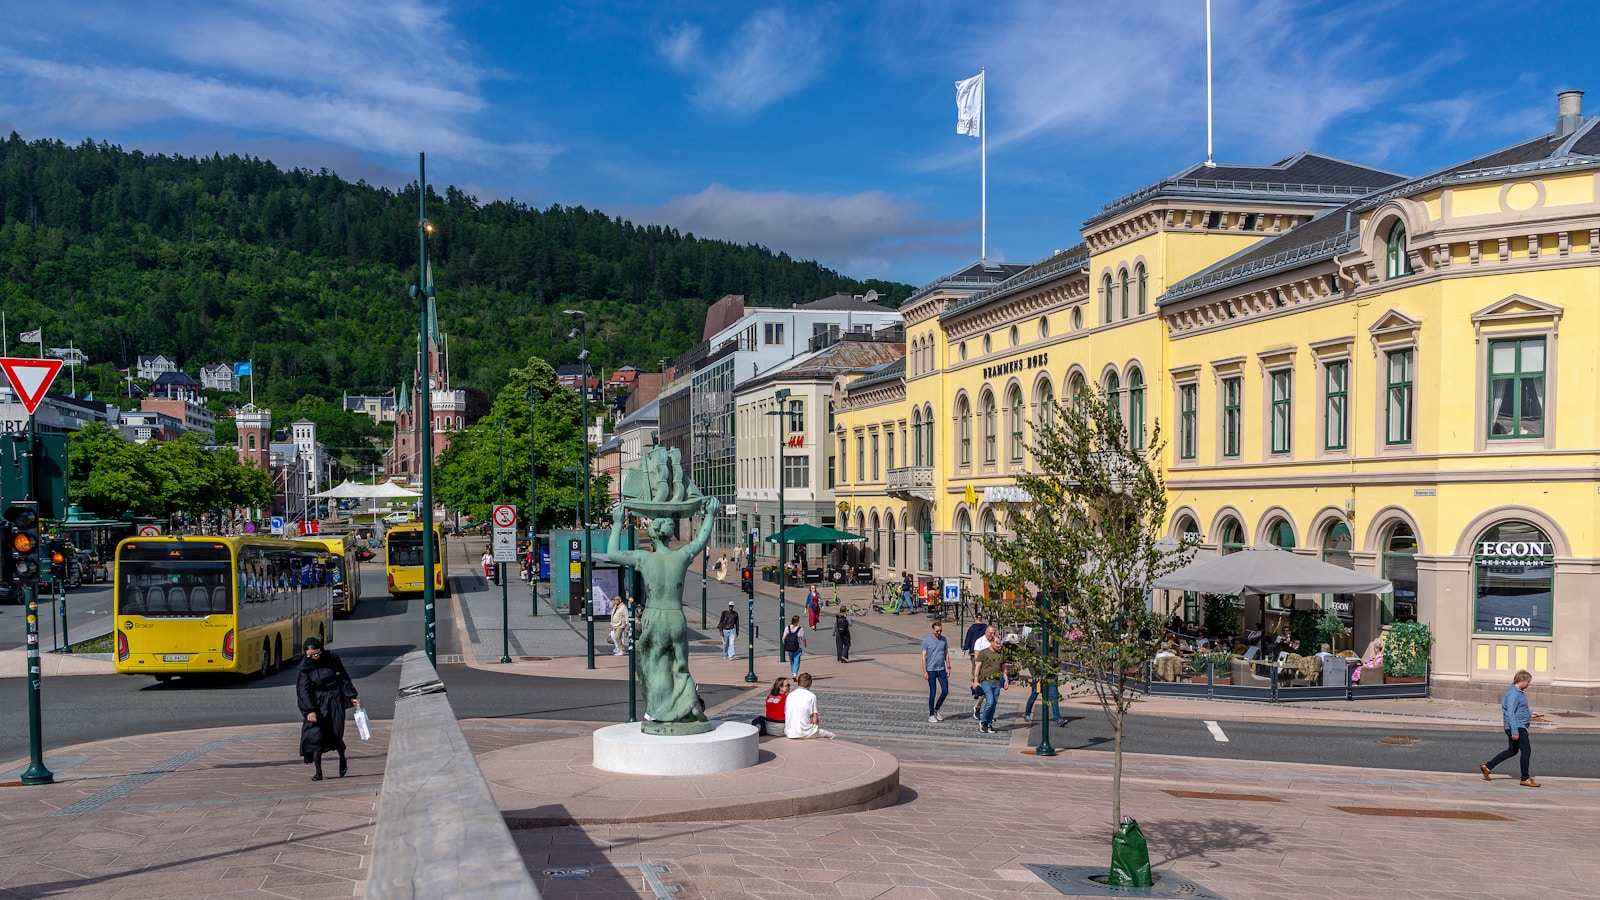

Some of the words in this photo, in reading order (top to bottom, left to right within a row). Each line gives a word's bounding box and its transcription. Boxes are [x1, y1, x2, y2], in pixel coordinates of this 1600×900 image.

[983, 359, 1023, 379] DRAMMENS
[1027, 353, 1048, 369] BØRS
[1184, 531, 1199, 543] EGO
[572, 541, 579, 549] B
[1483, 541, 1545, 557] EGON
[1332, 601, 1349, 611] EGON
[1494, 617, 1531, 627] EGON
